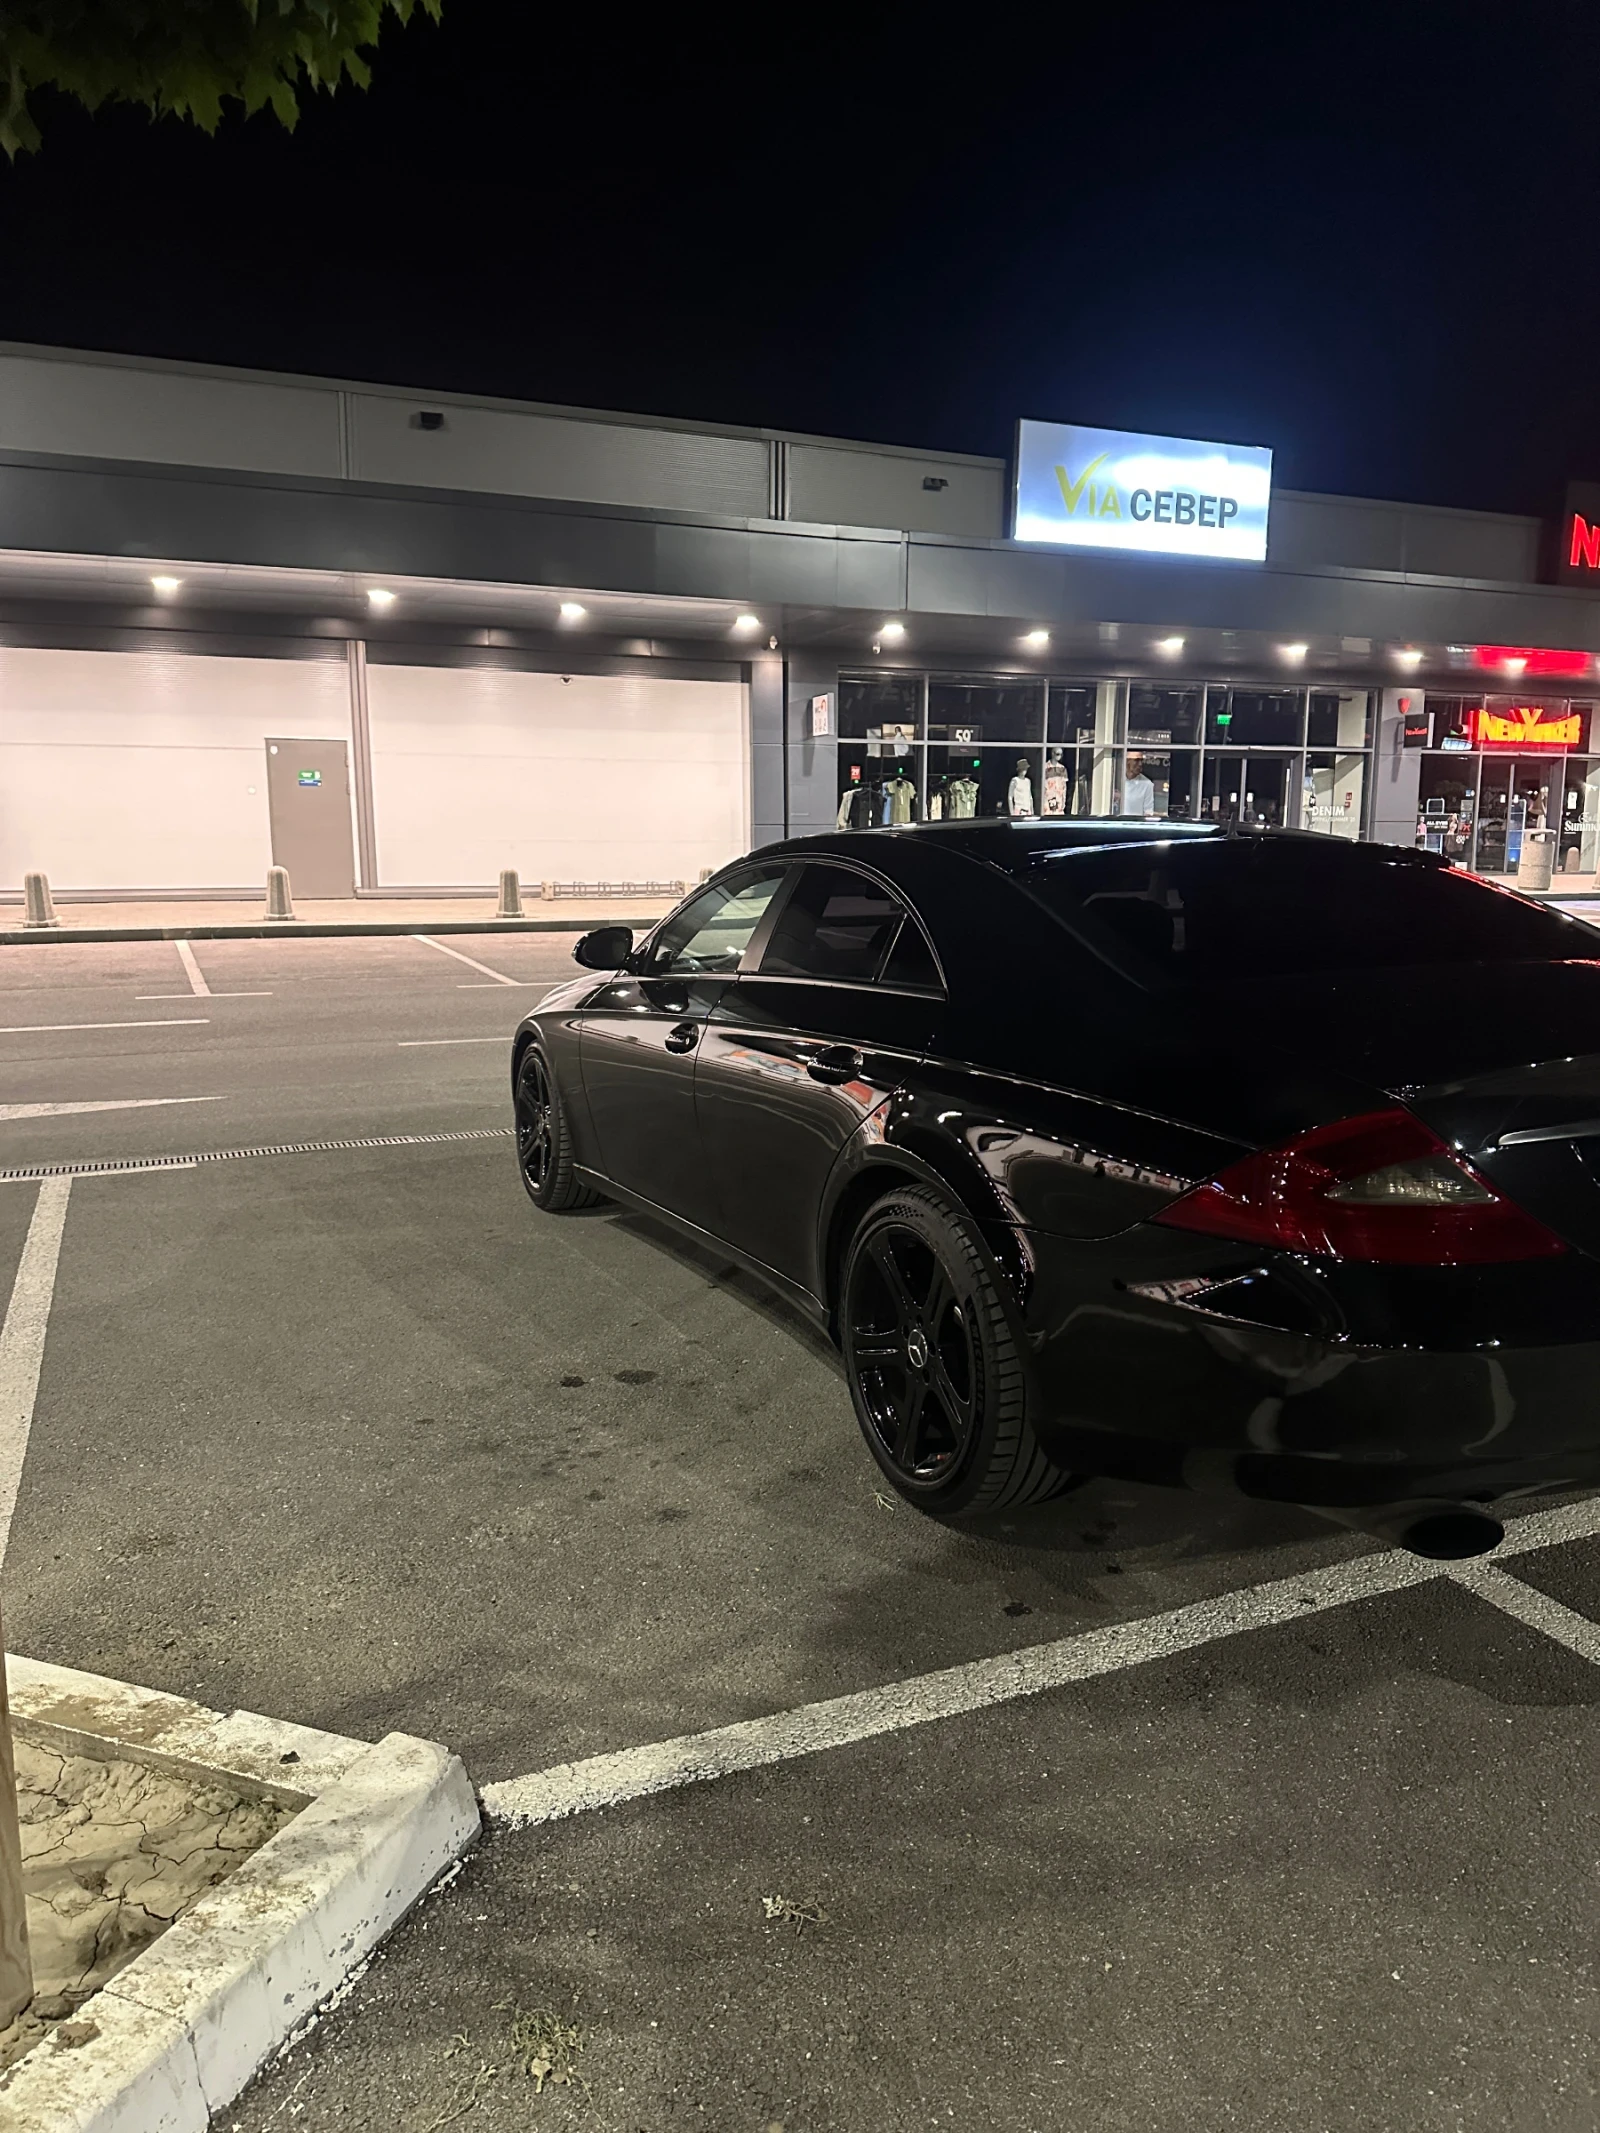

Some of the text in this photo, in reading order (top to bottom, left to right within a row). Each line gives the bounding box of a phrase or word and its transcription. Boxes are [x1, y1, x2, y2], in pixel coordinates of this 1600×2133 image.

[1055, 452, 1122, 519] VIA
[1569, 513, 1600, 569] N
[1311, 805, 1345, 817] DENIM
